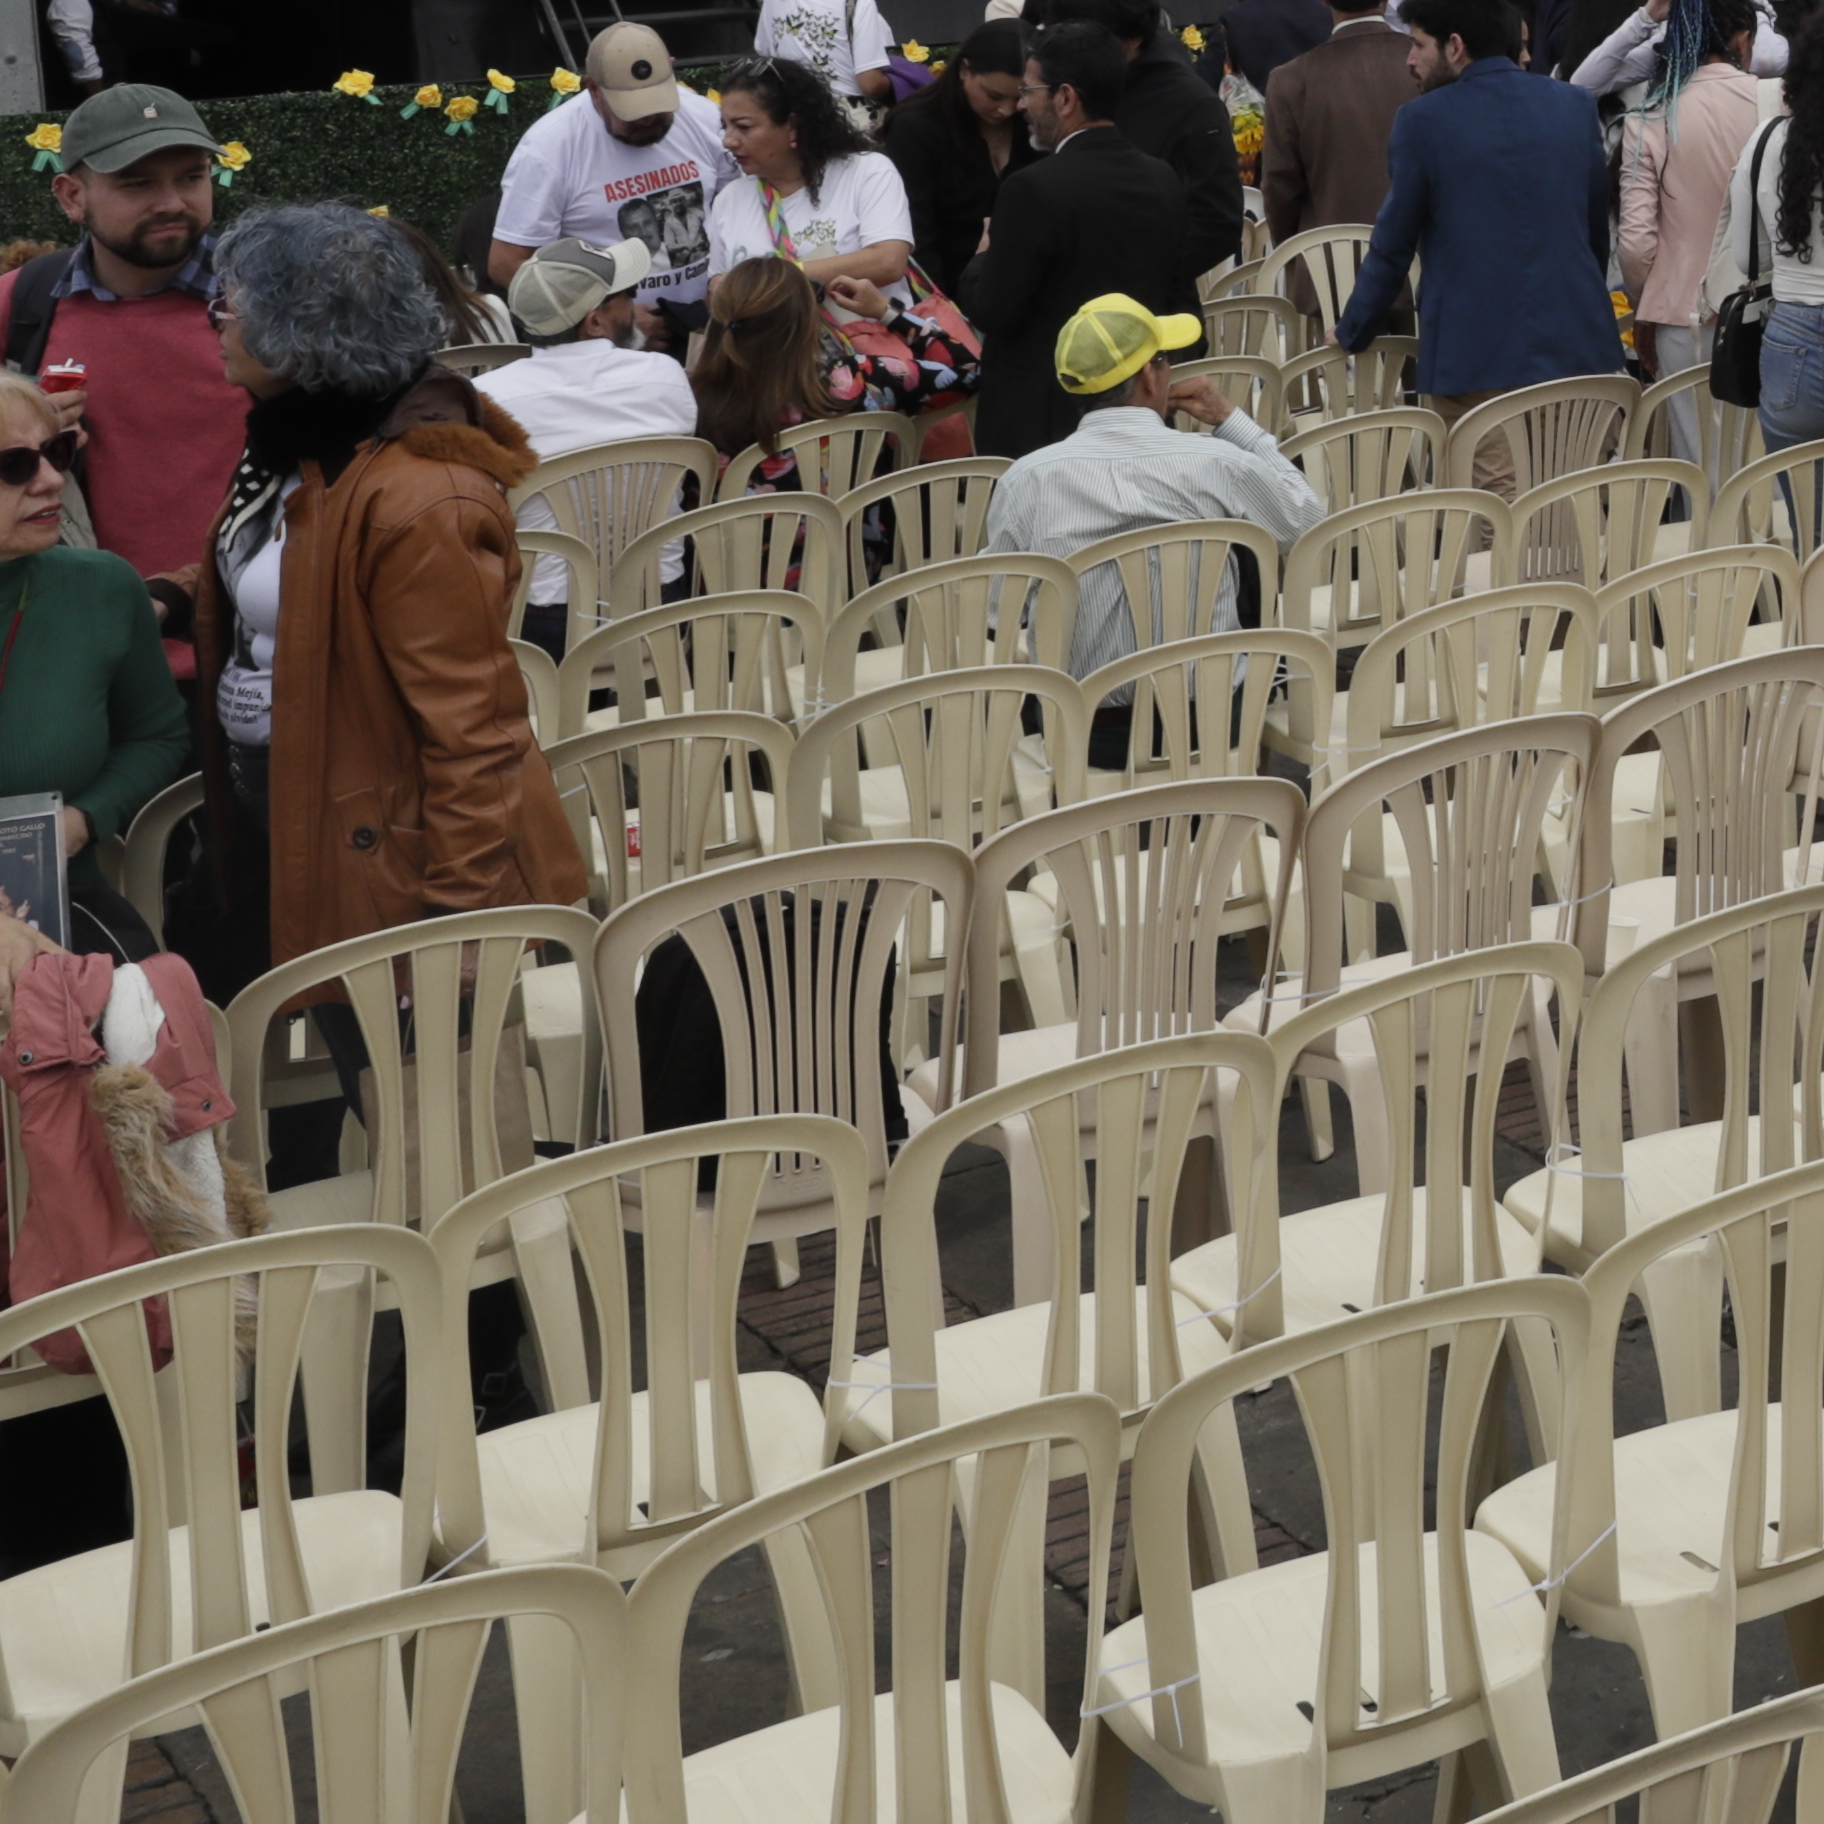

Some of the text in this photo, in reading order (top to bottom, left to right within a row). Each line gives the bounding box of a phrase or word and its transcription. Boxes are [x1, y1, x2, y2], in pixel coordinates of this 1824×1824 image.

[604, 160, 699, 203] ASESINADOS
[636, 274, 672, 291] varo
[674, 272, 682, 285] y
